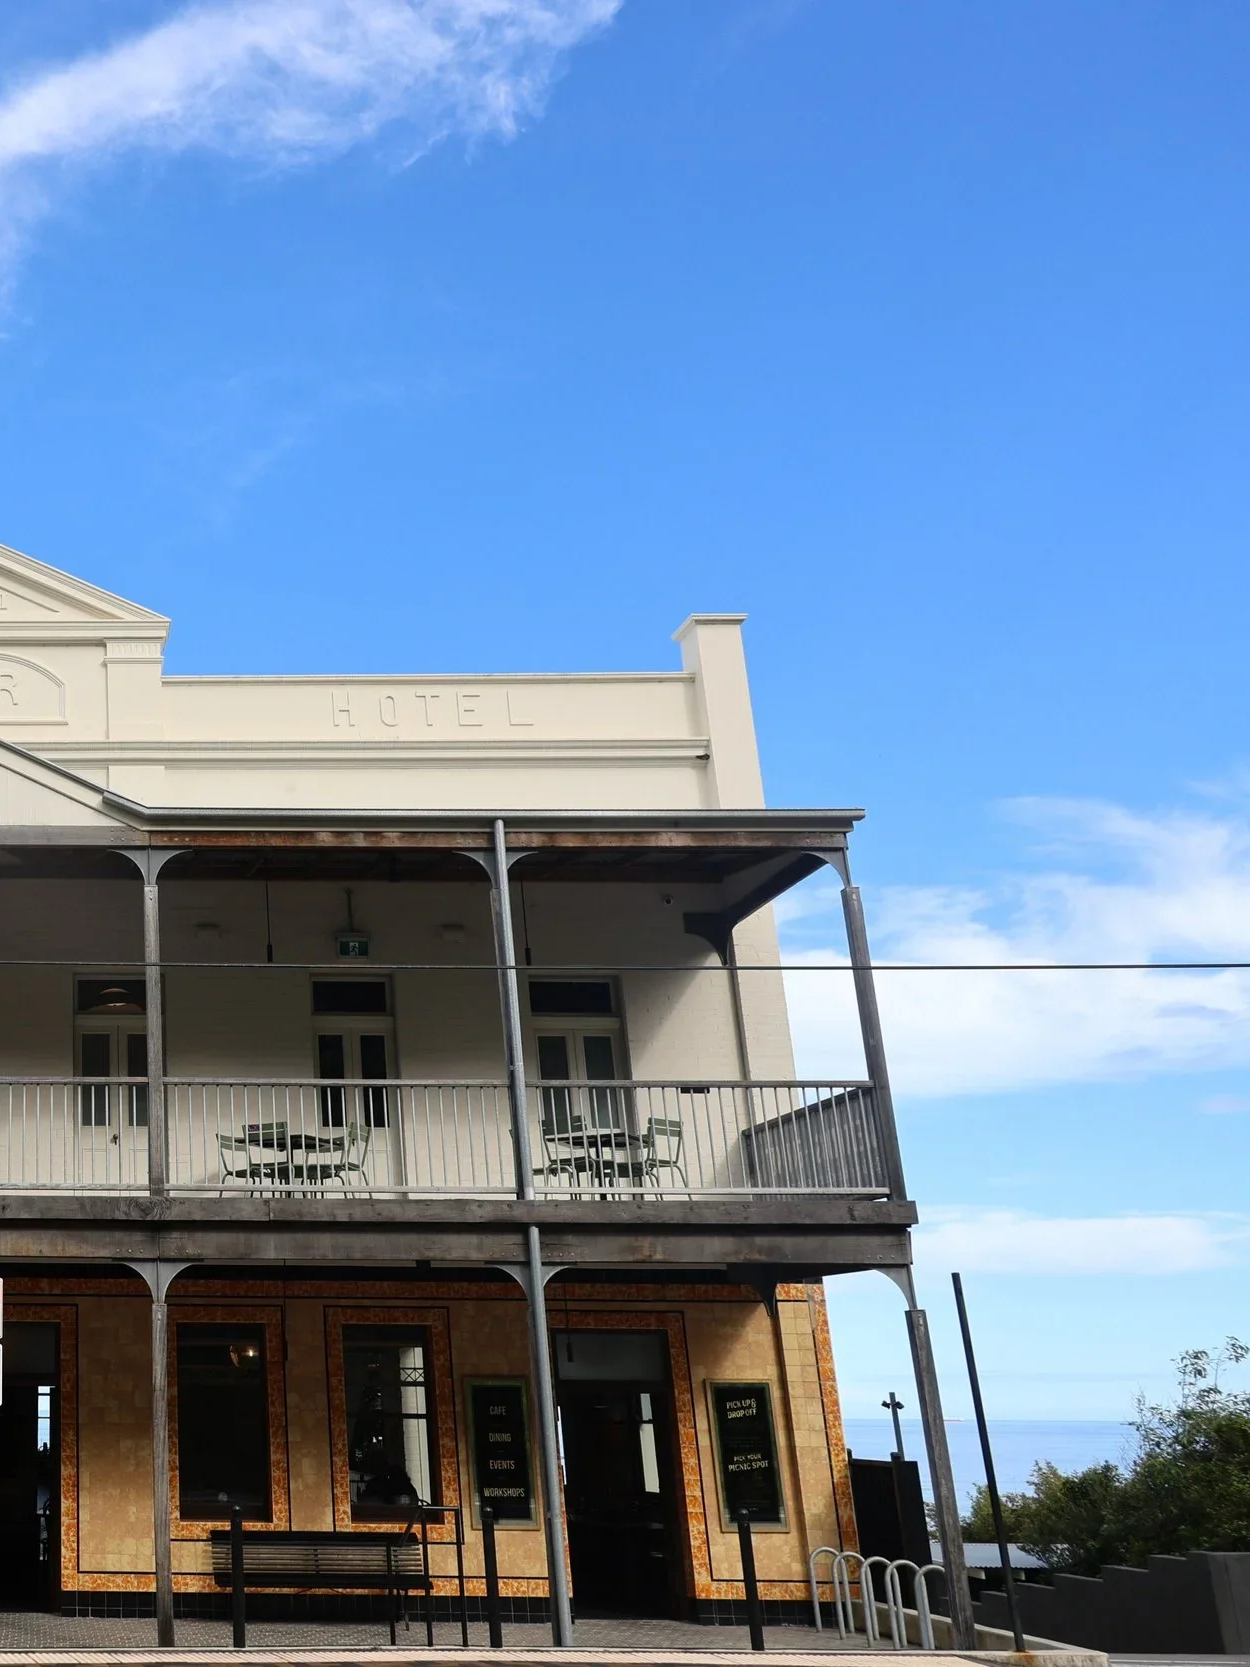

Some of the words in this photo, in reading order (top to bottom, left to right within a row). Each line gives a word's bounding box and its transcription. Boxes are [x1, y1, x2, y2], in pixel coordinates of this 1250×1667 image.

[331, 690, 535, 728] HOTEL
[726, 1400, 741, 1410] PICK
[742, 1399, 751, 1408] UP
[489, 1406, 507, 1415] CAFE
[727, 1410, 745, 1419] DROP
[745, 1408, 757, 1417] OFF
[489, 1433, 512, 1442] DINING
[489, 1460, 515, 1470] EVENTS
[728, 1462, 751, 1472] PICNIC
[751, 1460, 769, 1470] SPOT
[483, 1487, 525, 1497] WORKSHOPS
